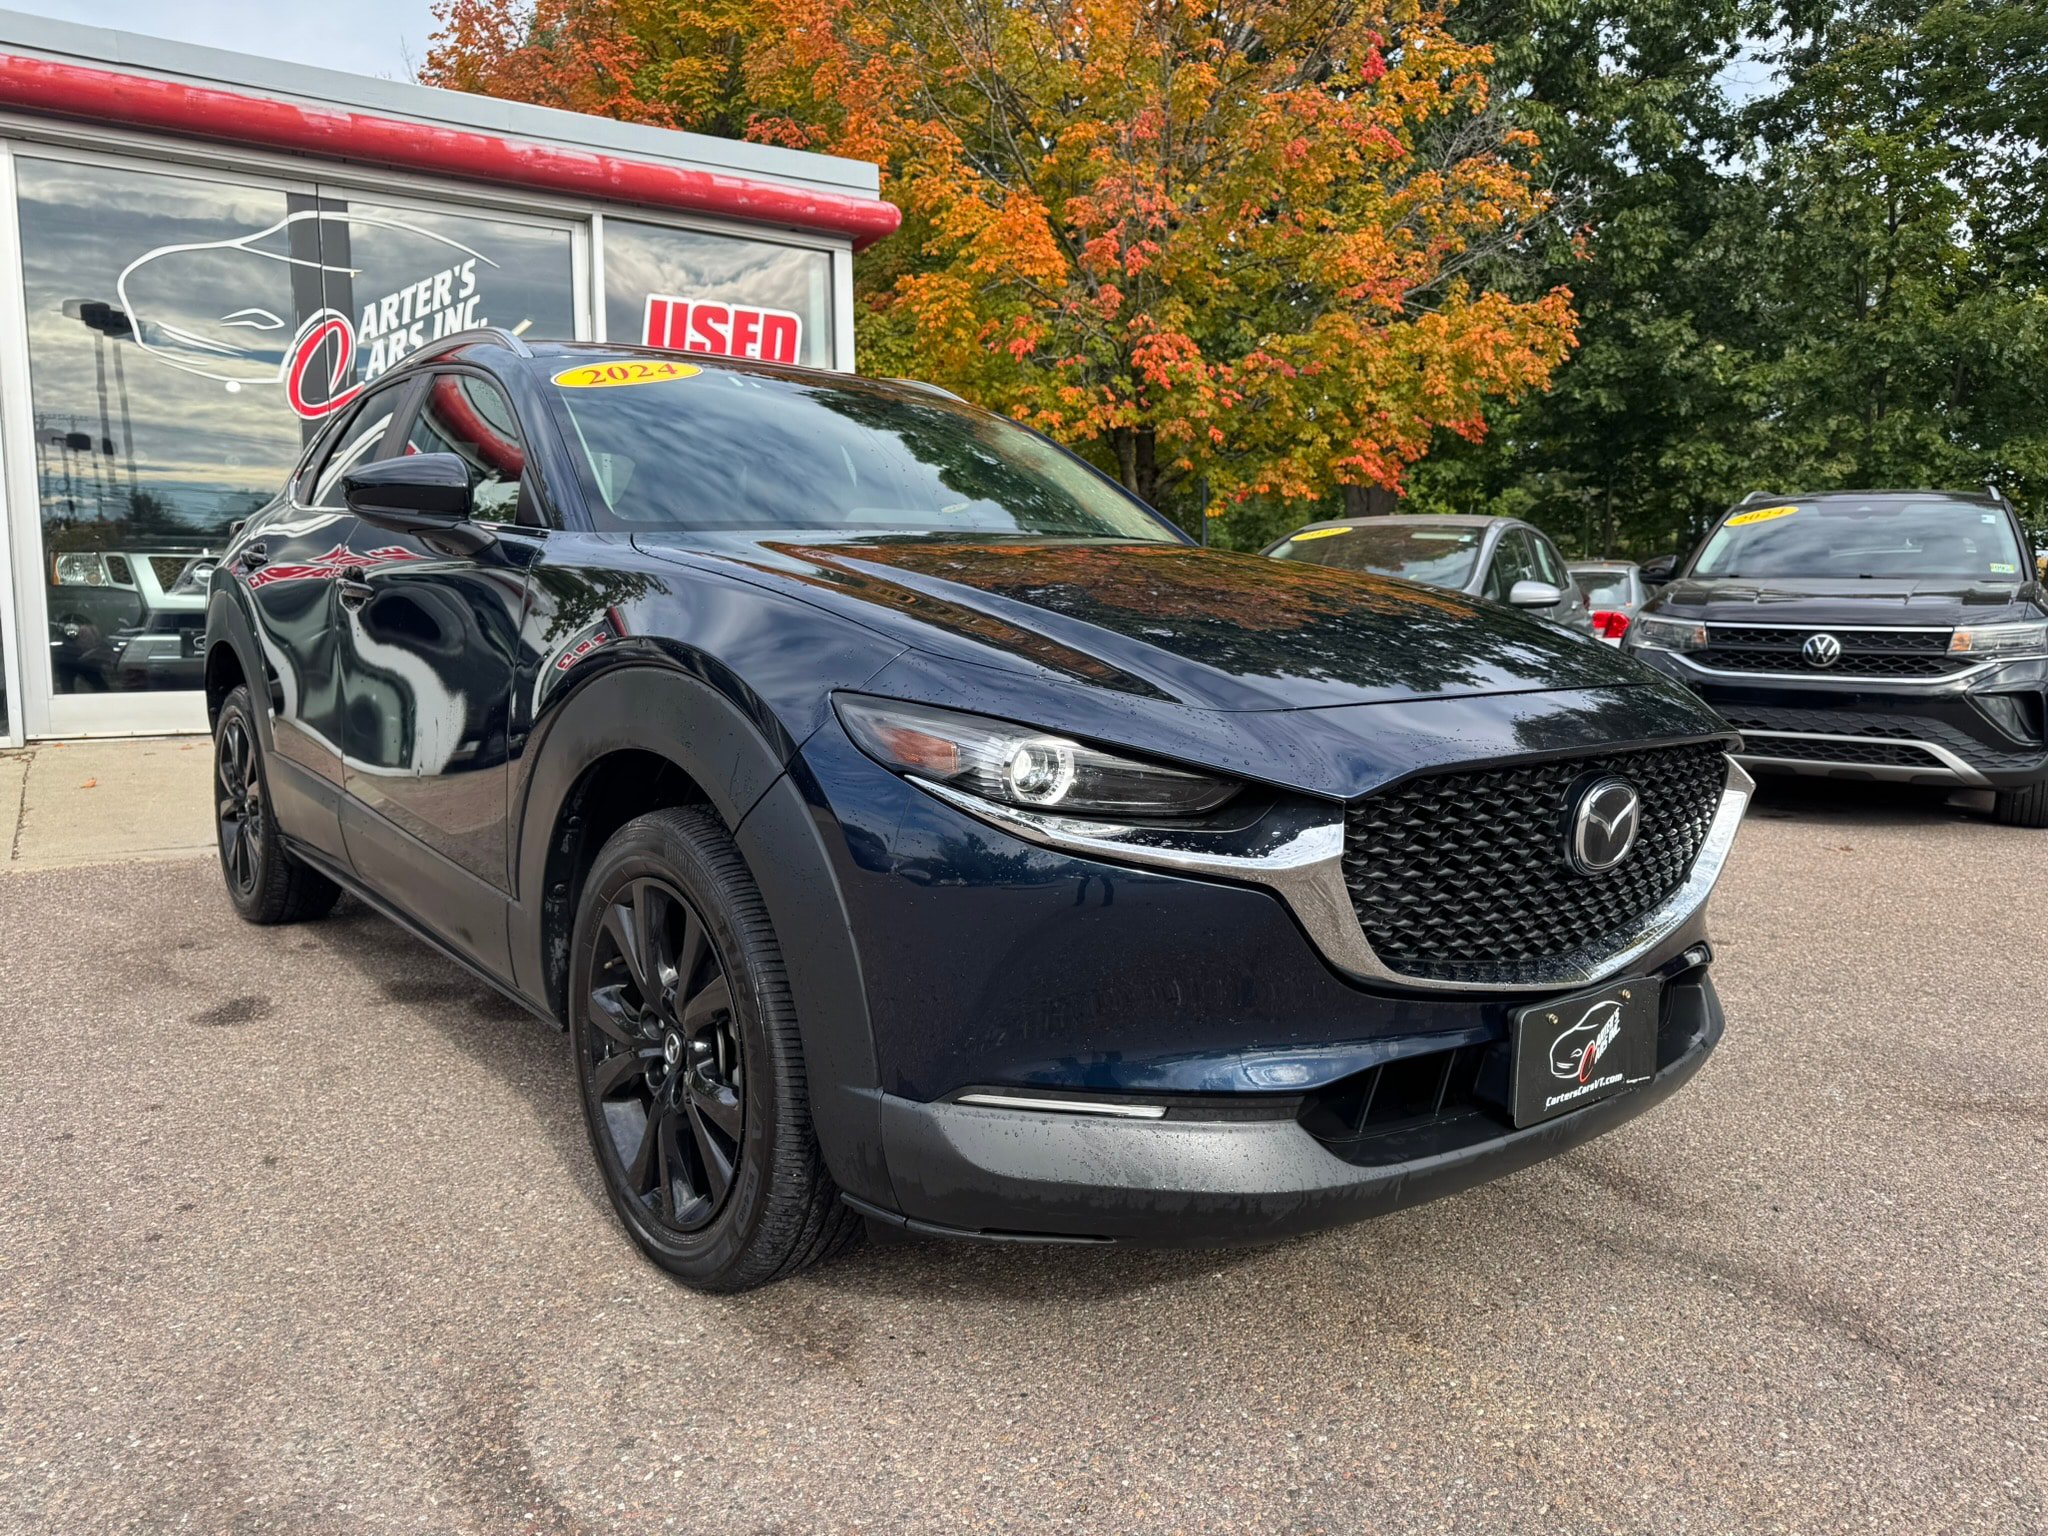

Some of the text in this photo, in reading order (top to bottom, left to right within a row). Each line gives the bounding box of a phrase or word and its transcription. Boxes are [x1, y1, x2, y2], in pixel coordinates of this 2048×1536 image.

[646, 299, 799, 366] USED
[581, 362, 679, 386] 2024
[1545, 1072, 1624, 1108] CartersCarsVT.com
